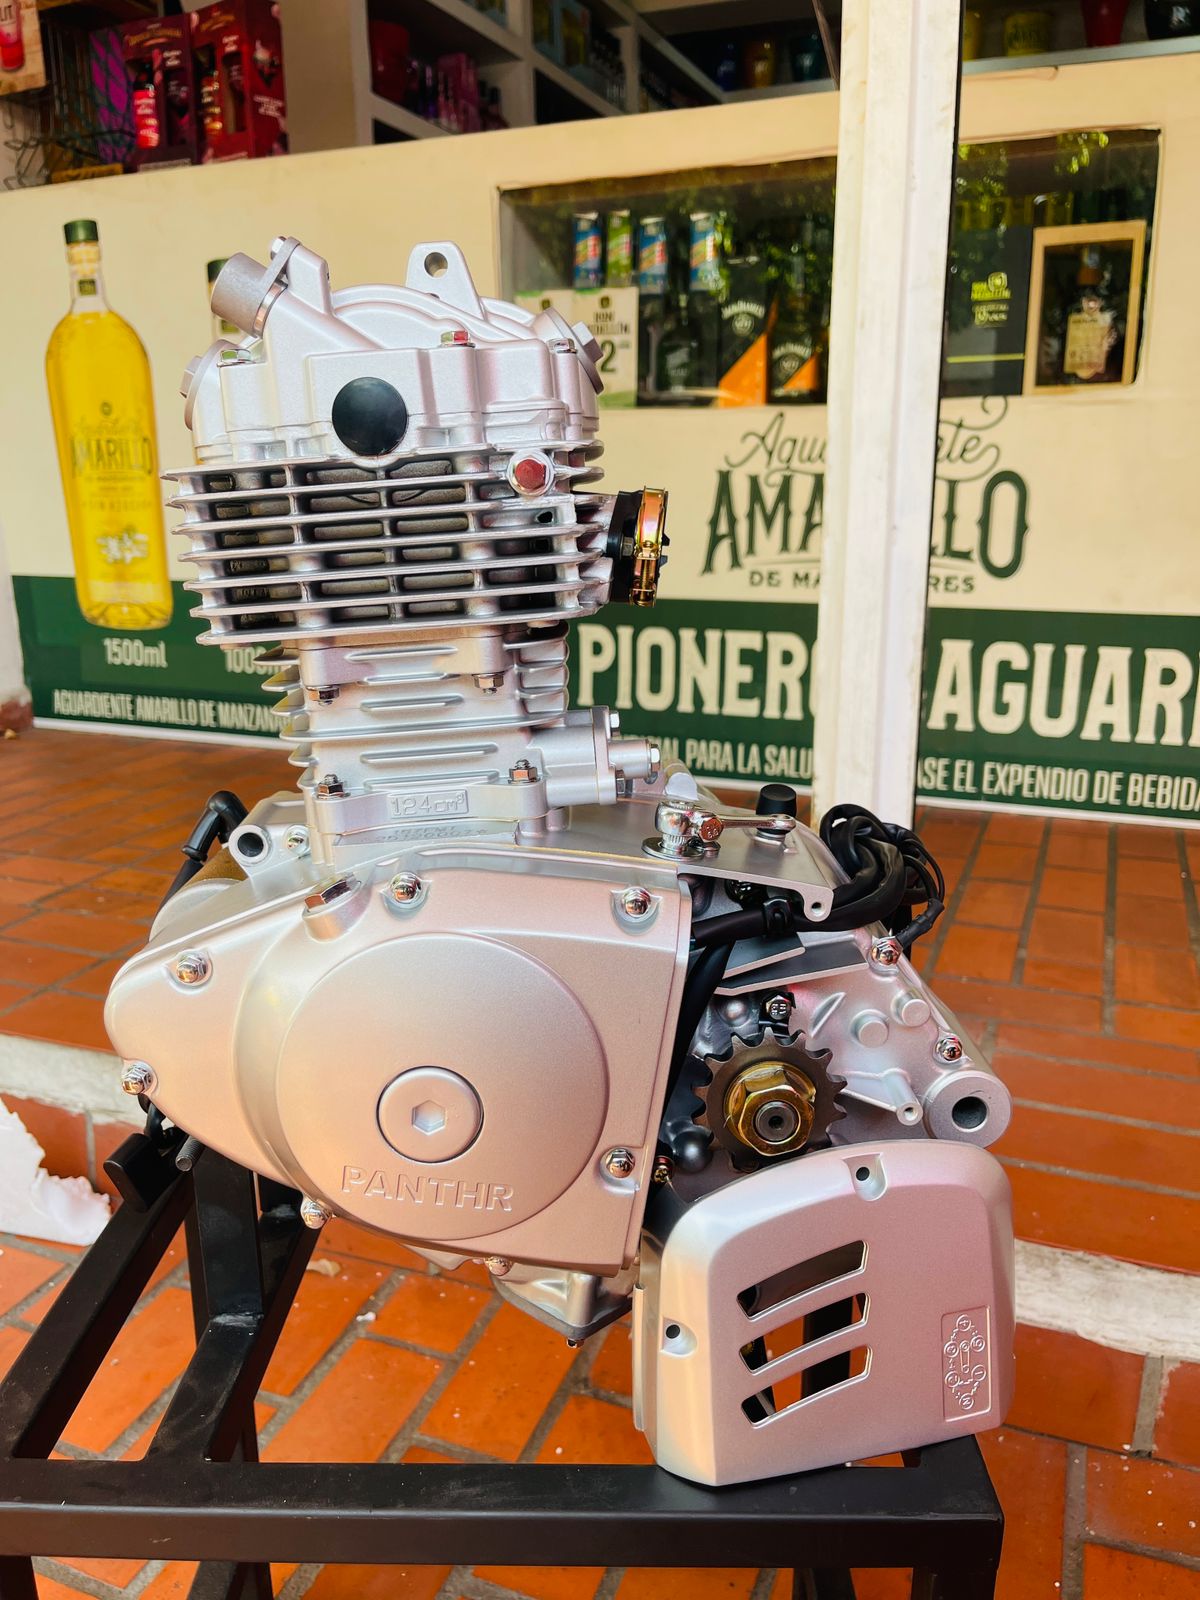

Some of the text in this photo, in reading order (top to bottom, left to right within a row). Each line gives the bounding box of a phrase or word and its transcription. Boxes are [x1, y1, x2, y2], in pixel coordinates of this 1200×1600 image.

[750, 571, 780, 587] DE
[103, 637, 167, 669] 1500ml
[576, 622, 818, 721] PIONER
[136, 695, 197, 726] AMARILLO
[197, 699, 216, 727] DE
[926, 637, 1200, 751] AGUAR
[685, 738, 733, 774] PARA
[736, 742, 761, 777] LA
[763, 743, 813, 780] SALU
[953, 759, 978, 793] EL
[981, 761, 1089, 803] EXPENDIO
[1092, 770, 1125, 806] DE
[342, 1165, 513, 1211] PANTHR
